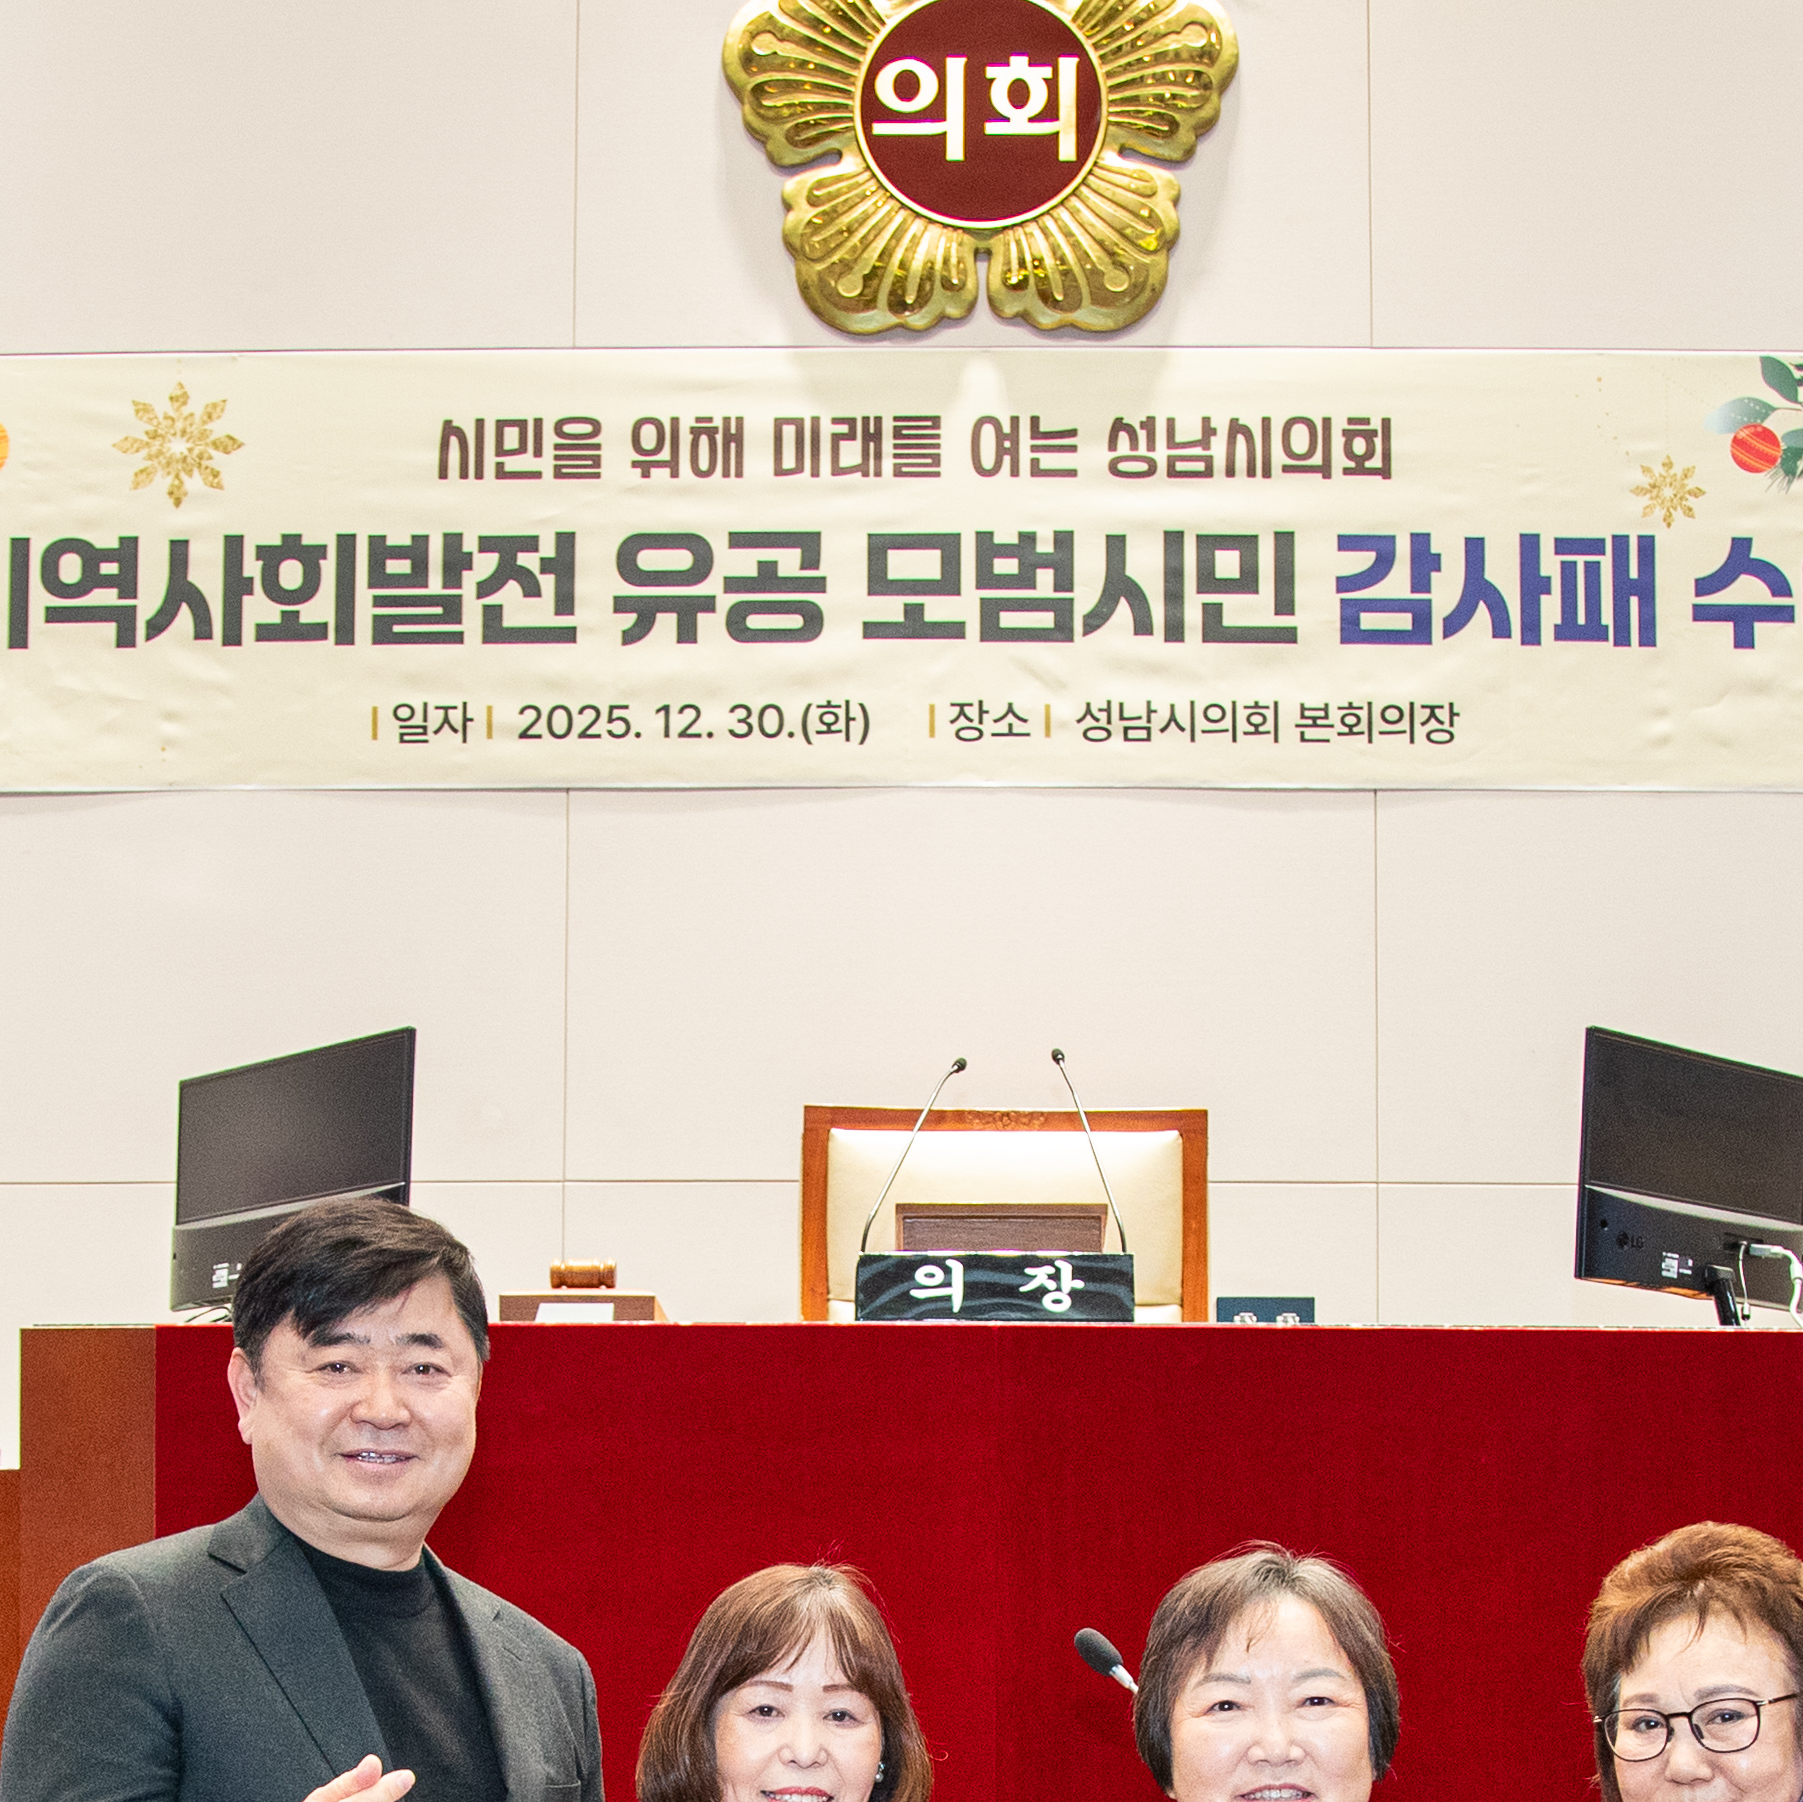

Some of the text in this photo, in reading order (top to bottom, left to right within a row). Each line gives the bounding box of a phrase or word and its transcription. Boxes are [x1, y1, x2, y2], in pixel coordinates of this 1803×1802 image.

[871, 53, 1080, 162] 의회
[438, 415, 1392, 480] 시민을 위해 미래를 여는 성남시의회
[613, 531, 827, 646] 유공
[862, 530, 1298, 644] 모범시민
[1335, 532, 1658, 647] 감사패
[518, 704, 641, 739] 2025.
[655, 704, 714, 739] 12.
[1076, 700, 1279, 743] 성남시의회
[1295, 701, 1460, 745] 본회의장
